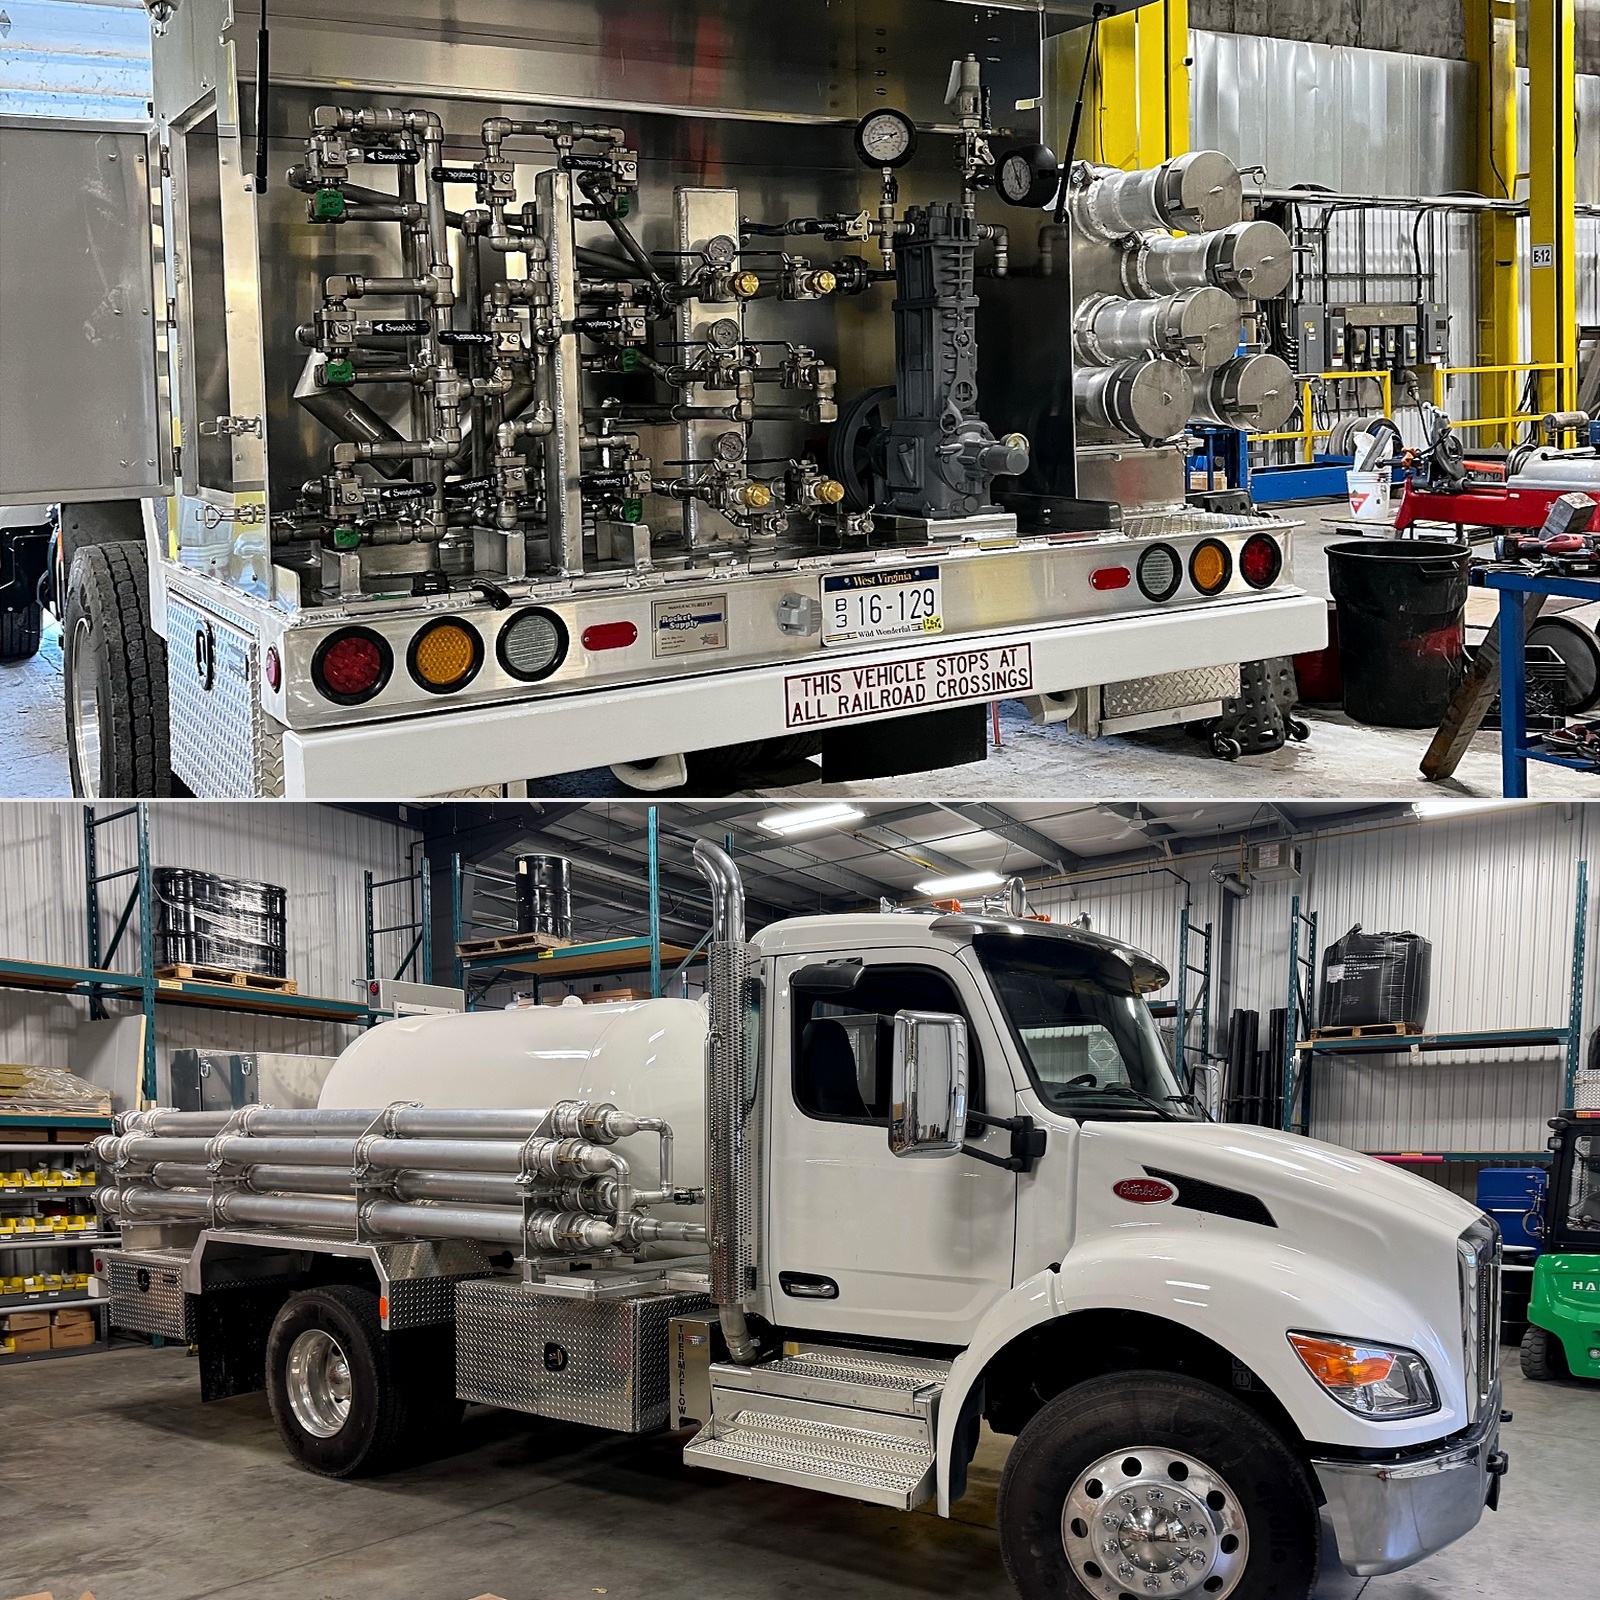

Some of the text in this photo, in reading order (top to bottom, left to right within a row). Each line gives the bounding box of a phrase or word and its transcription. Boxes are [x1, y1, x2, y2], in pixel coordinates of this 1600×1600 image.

[1534, 249, 1550, 263] E-12
[853, 571, 912, 586] West Virginia
[835, 598, 847, 612] B
[859, 588, 935, 626] 16-129
[661, 613, 692, 624] Rocket
[669, 620, 699, 630] Supply
[858, 625, 911, 638] Wild Wonderful
[801, 648, 1018, 697] THIS VEHICLE STOPS AT
[792, 667, 1028, 723] ALL RAILROAD CROSSINGS
[1120, 1181, 1167, 1197] Peterbilt
[1572, 1281, 1600, 1291] HA
[677, 1324, 687, 1415] THERMAFLOW
